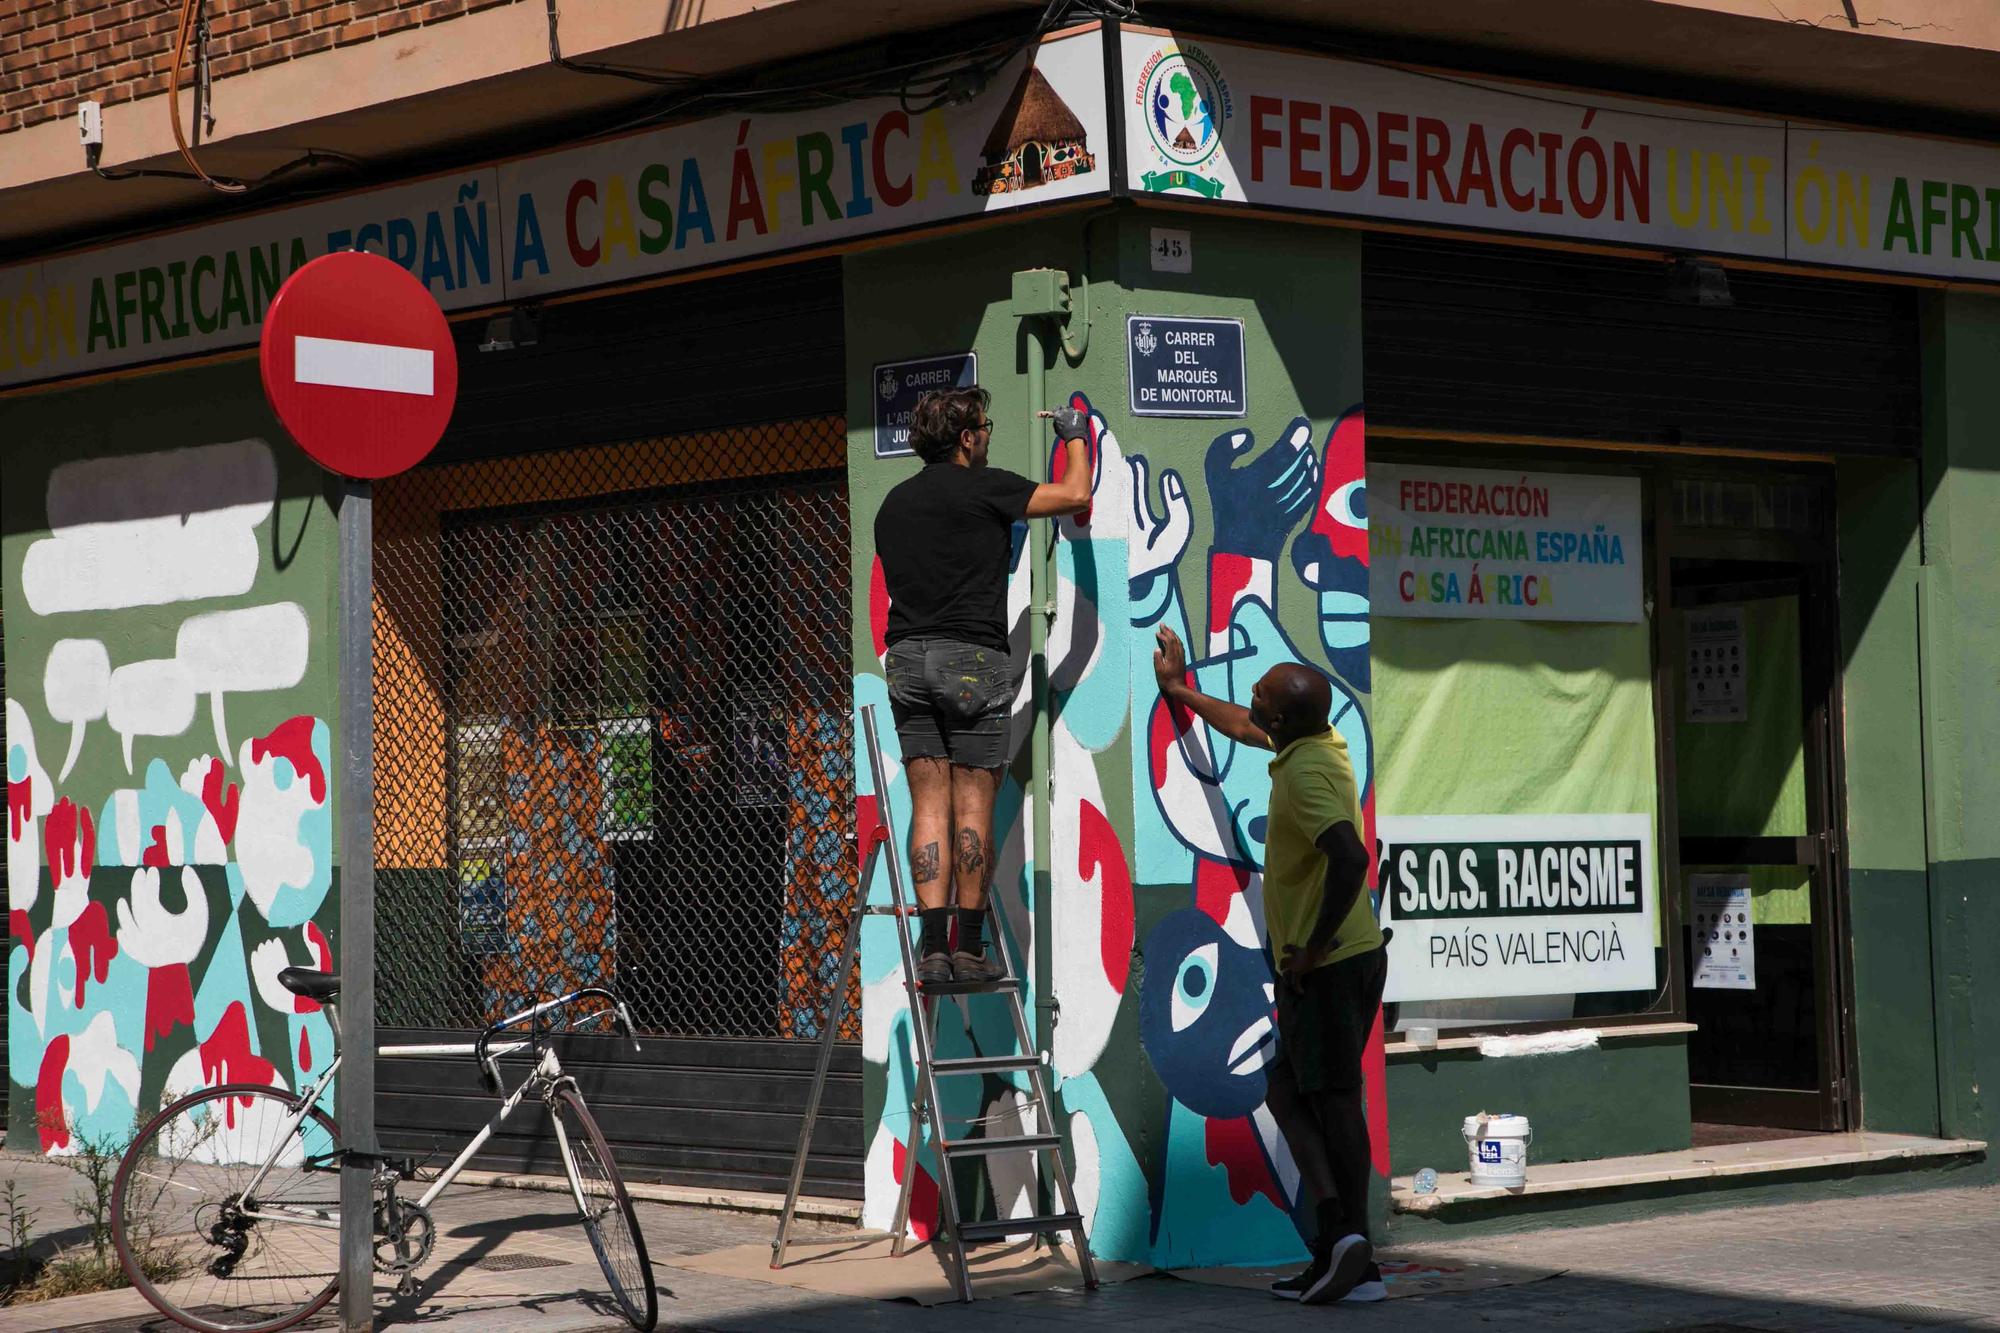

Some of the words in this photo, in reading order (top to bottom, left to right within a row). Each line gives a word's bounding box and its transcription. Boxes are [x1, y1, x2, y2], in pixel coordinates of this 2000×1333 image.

[1250, 95, 1650, 224] FEDERACIÓN
[565, 157, 716, 268] CASA
[726, 108, 960, 242] ÁFRICA
[1156, 238, 1183, 258] 45
[1165, 331, 1215, 347] CARRER
[1174, 350, 1200, 365] DEL
[905, 369, 951, 387] CARRER
[1140, 387, 1158, 402] DE
[1161, 388, 1236, 403] MONTORTAL
[1157, 367, 1218, 384] MARQUÉS
[1400, 476, 1549, 518] FEDERACIÓN
[1409, 526, 1530, 561] AFRICANA
[1536, 525, 1625, 565] ESPAÑA
[1399, 570, 1461, 603] CASA
[1467, 563, 1553, 606] ÁFRICA
[1399, 848, 1487, 912] S.O.S.
[1497, 847, 1635, 909] RACISME
[1430, 926, 1488, 968] PAÍS
[1496, 921, 1625, 965] VALENCIÀ
